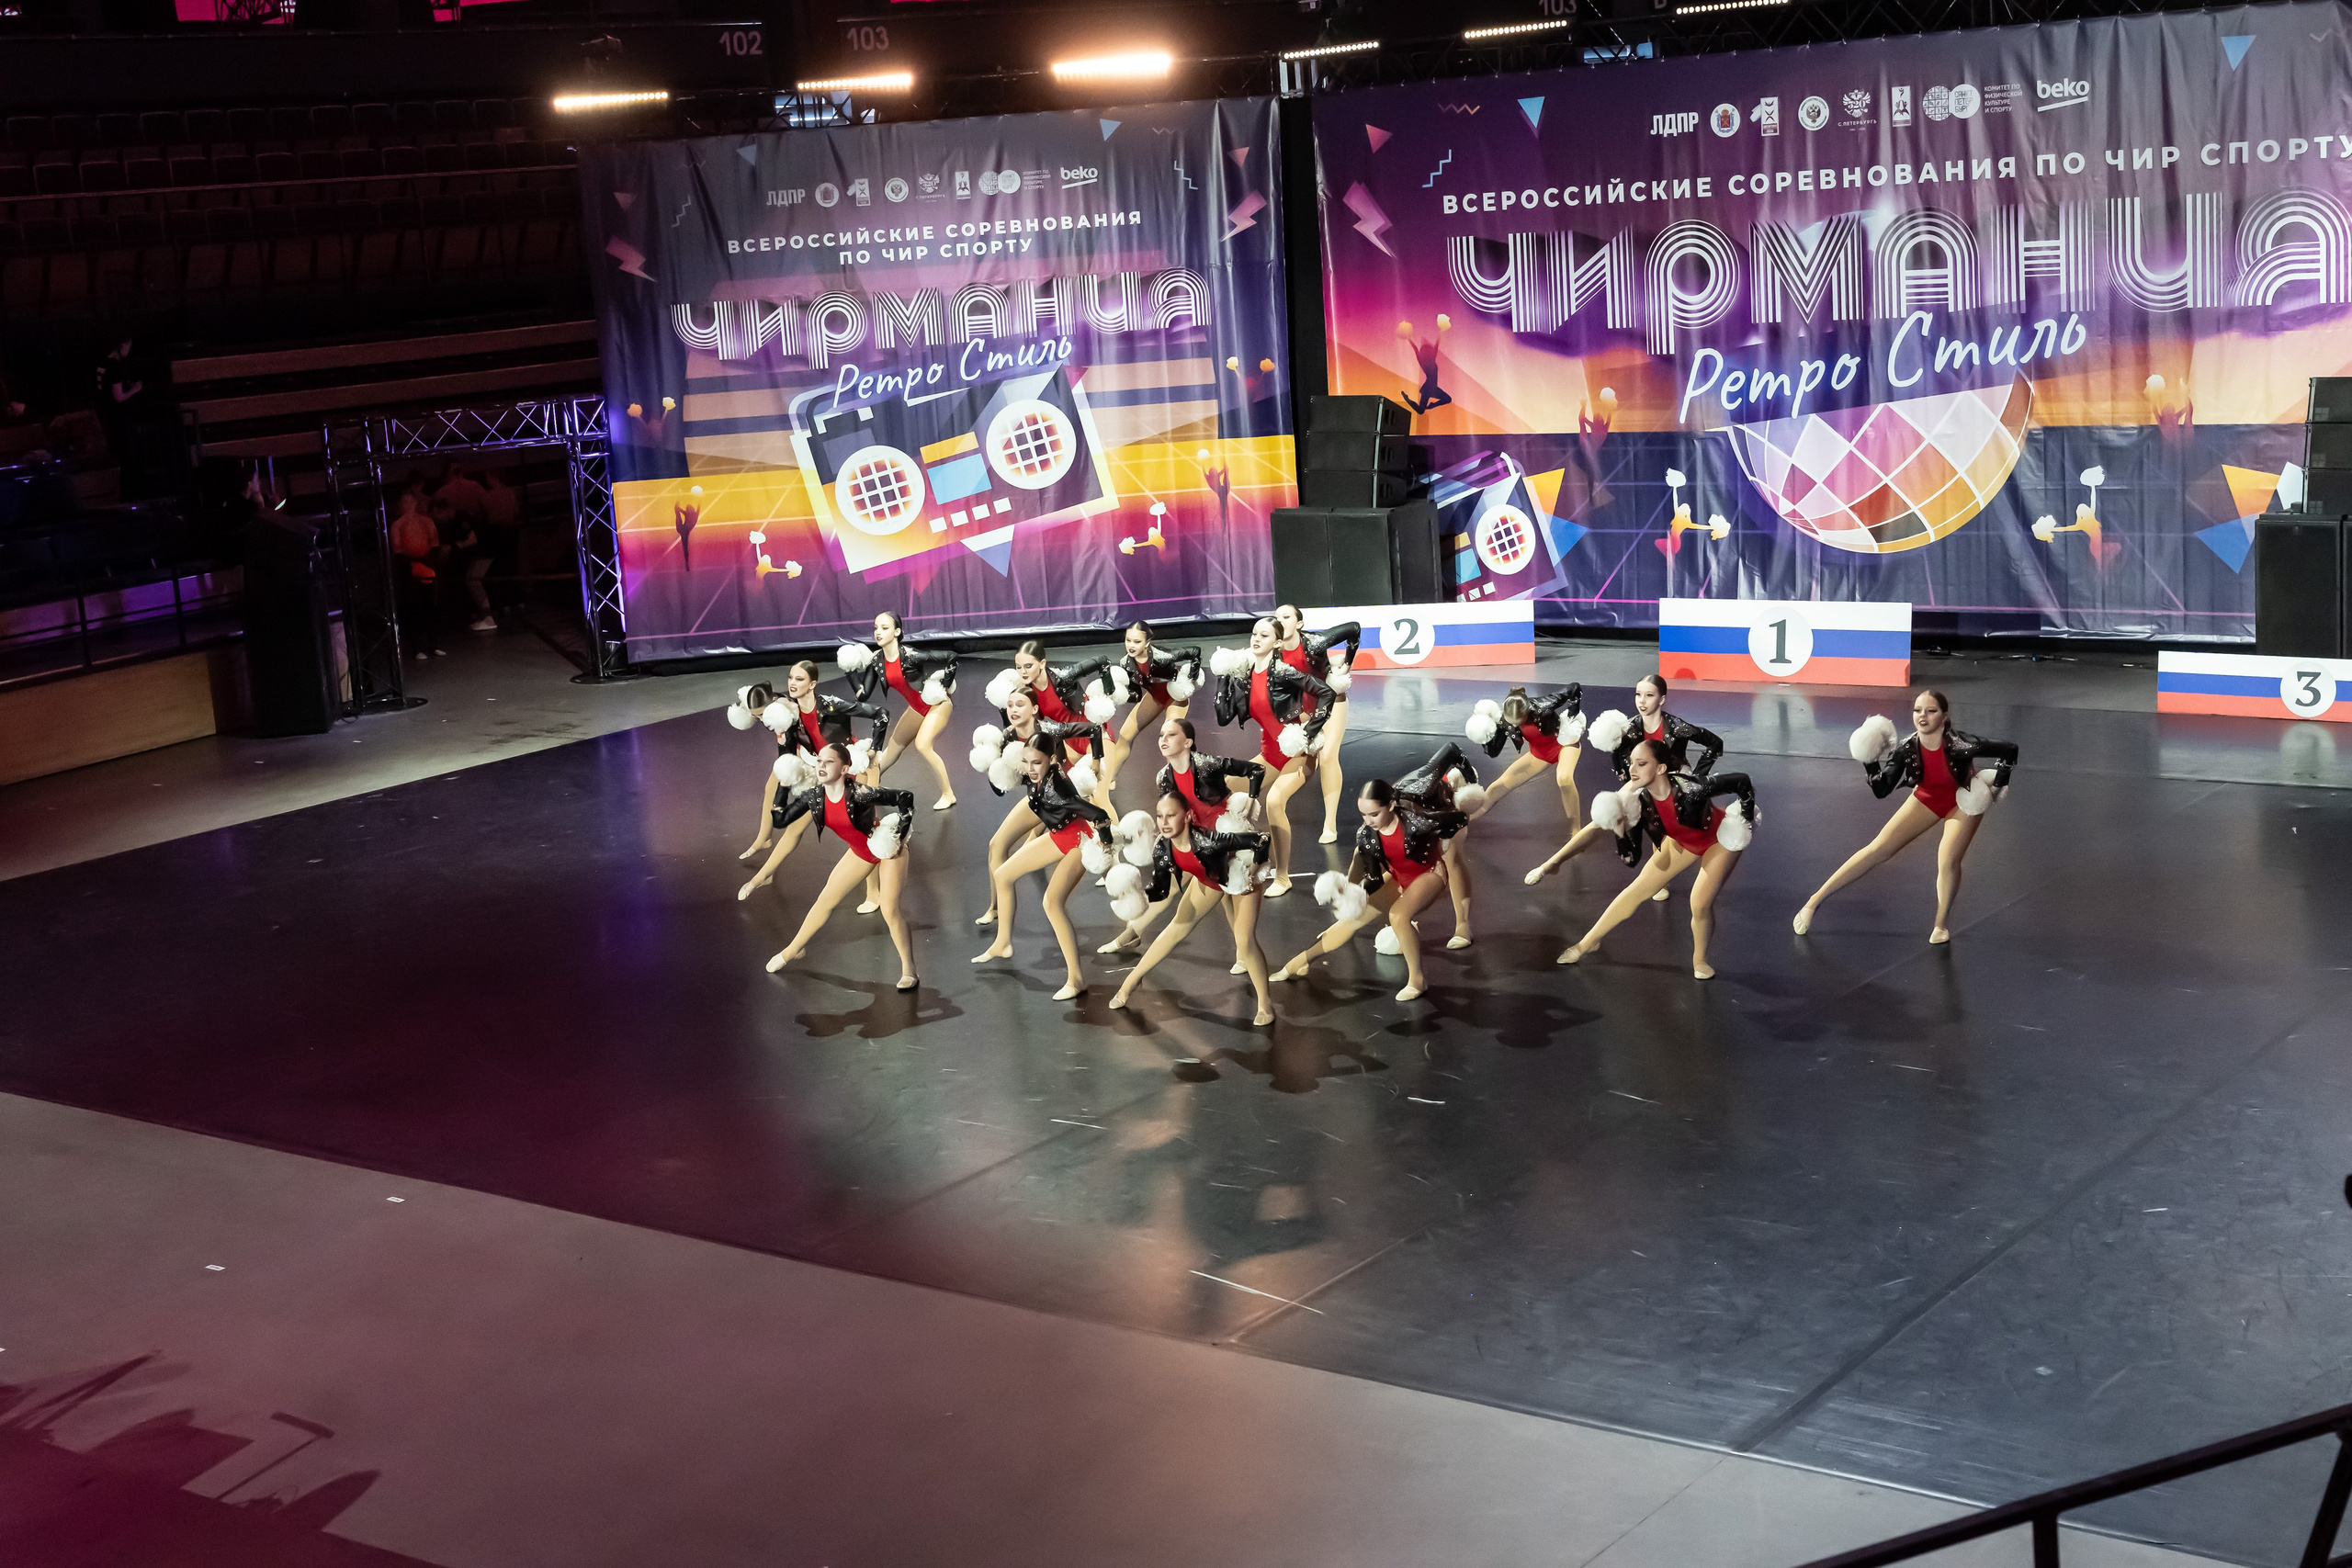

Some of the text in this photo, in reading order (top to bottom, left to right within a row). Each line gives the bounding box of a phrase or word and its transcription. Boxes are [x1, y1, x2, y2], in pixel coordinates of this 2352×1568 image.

[718, 30, 763, 56] 102
[846, 25, 889, 51] 103
[1984, 89, 2023, 99] ФИЗИЧЕСКОЙ
[2036, 78, 2090, 99] beko
[1984, 98, 2011, 107] КУЛЬТУРЕ
[1650, 111, 1699, 138] ЛДПР
[1060, 165, 1099, 181] beko
[1442, 134, 2352, 215] ВСЕРОССИЙСКИЕ СОРЕВНОВАНИЯ ПО ЧИР СПОРТУ
[766, 188, 806, 208] ЛДПР
[727, 210, 1141, 254] ВСЕРОССИЙСКИЕ СОРЕВНОВАНИЯ
[839, 238, 1033, 265] ПО ЧИР СПОРТУ
[832, 334, 1072, 409] Ретро Стиль
[1679, 310, 2086, 424] Ретро Стиль
[1393, 617, 1420, 655] 2
[1769, 618, 1792, 664] 1
[2295, 671, 2322, 707] 3
